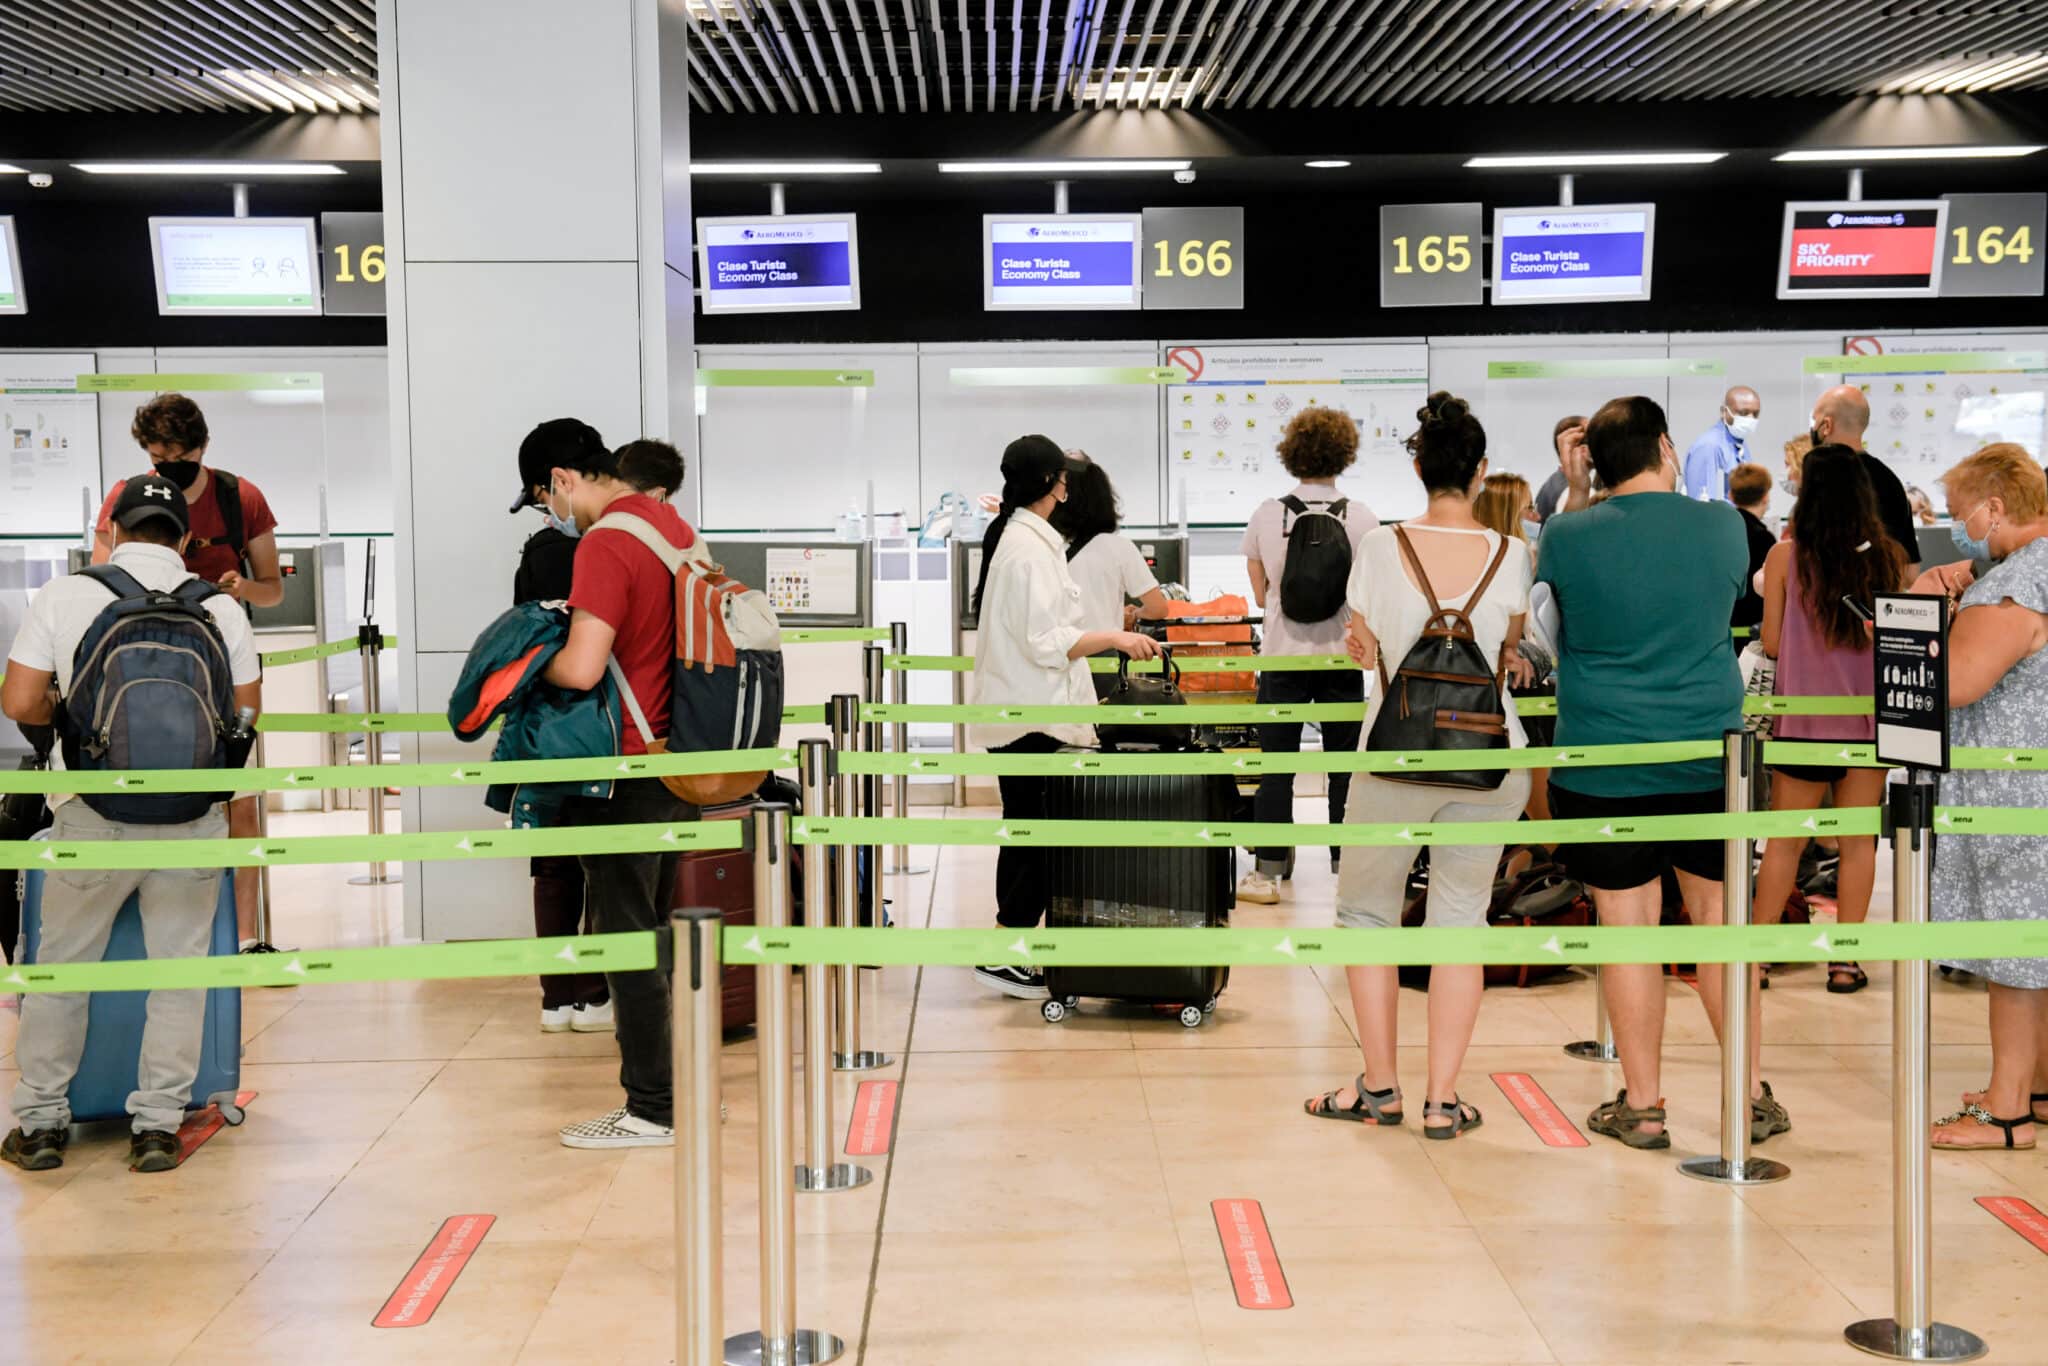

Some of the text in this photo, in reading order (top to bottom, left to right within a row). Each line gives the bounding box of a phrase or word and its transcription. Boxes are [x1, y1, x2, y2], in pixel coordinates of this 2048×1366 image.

[1797, 243, 1831, 255] SKY
[1952, 225, 2034, 265] 164
[1153, 239, 1234, 278] 166
[1392, 235, 1472, 274] 165
[1510, 250, 1580, 262] Clase Turista
[1796, 254, 1873, 267] PRIORITY
[717, 260, 786, 272] Clase Turista
[1001, 258, 1070, 269] Clase Turista
[1510, 261, 1590, 274] Economy Class
[718, 271, 798, 283] Economy Class
[1001, 269, 1081, 281] Economy Class
